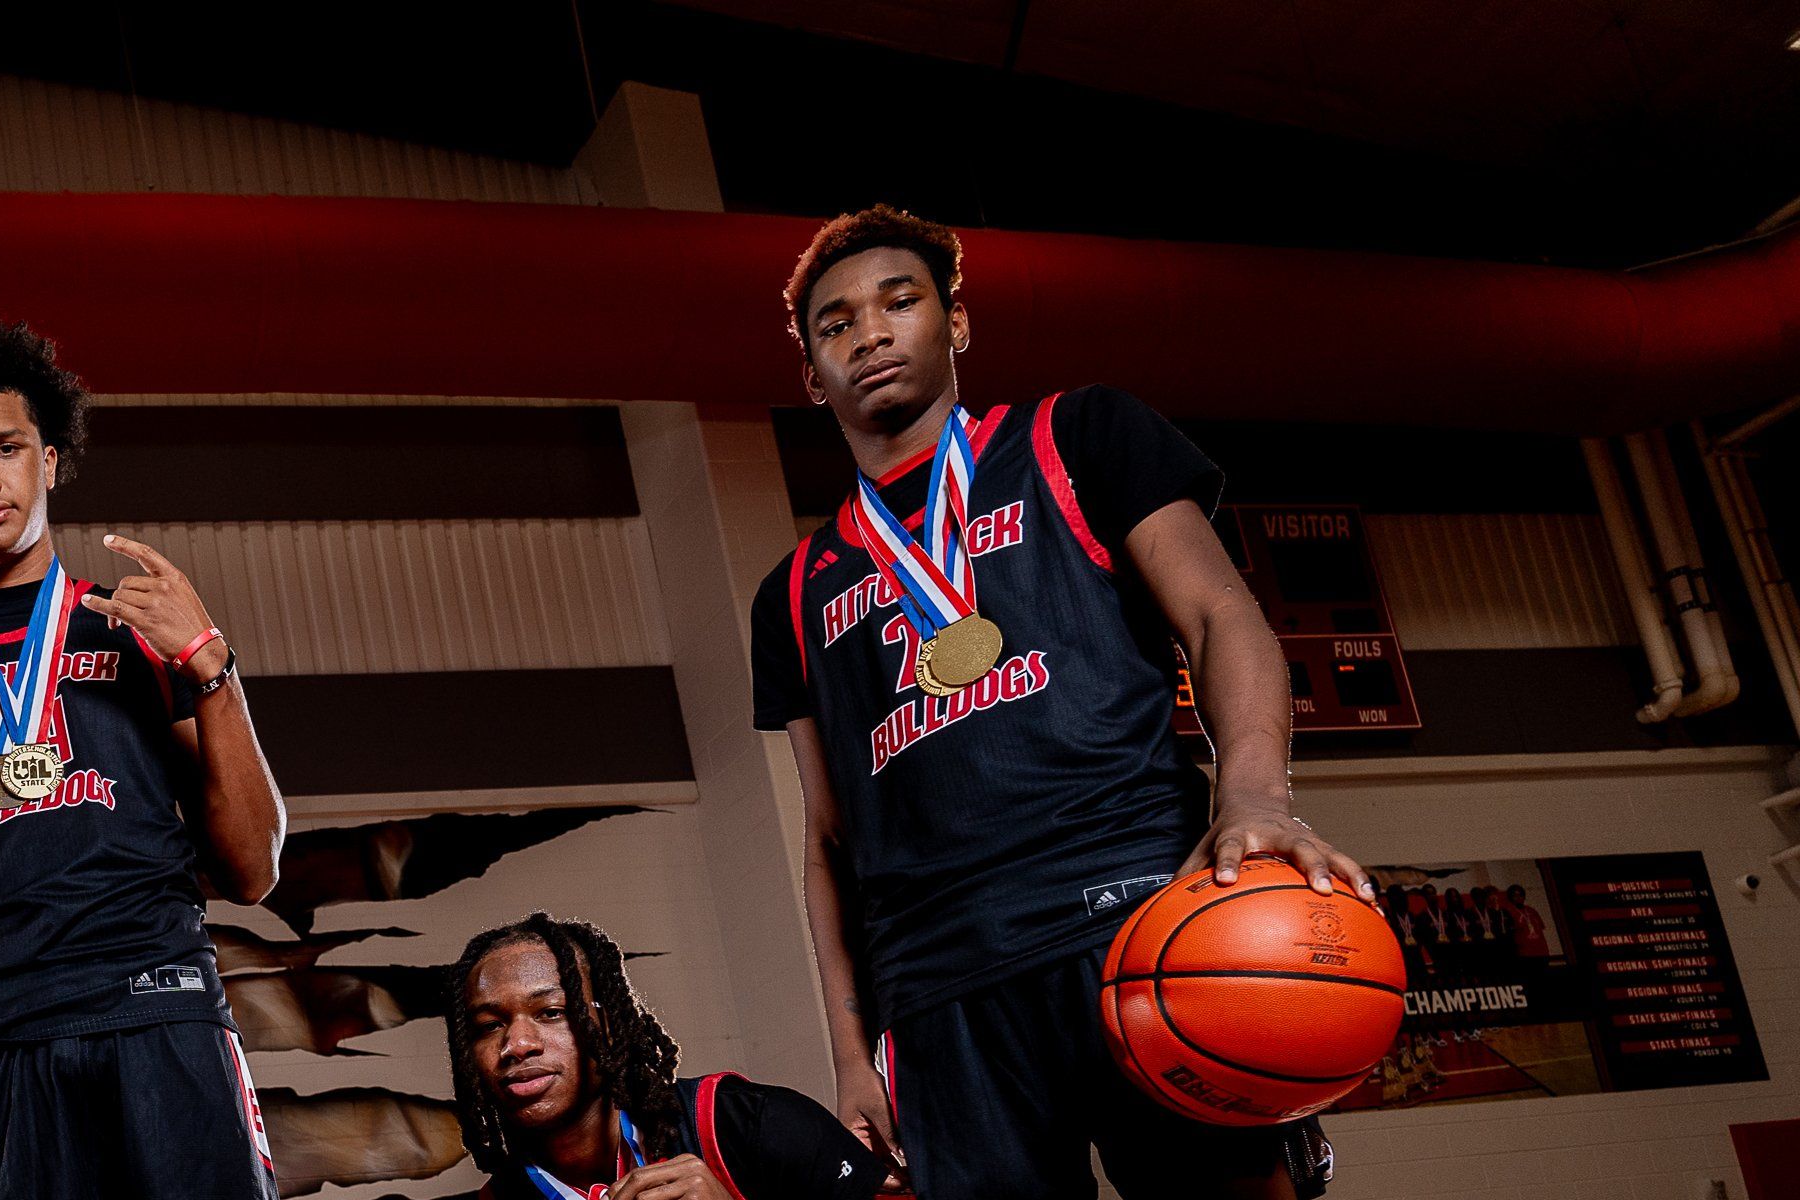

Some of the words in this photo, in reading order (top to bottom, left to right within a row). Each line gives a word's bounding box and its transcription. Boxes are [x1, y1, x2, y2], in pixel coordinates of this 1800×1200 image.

[1263, 514, 1351, 539] VISITOR
[1334, 641, 1382, 657] FOULS
[871, 650, 1050, 776] BULLDOGS
[1358, 710, 1388, 723] WON
[1630, 908, 1654, 917] AREA
[1592, 935, 1634, 946] REGIONAL
[1638, 930, 1707, 943] QUARTERFINALS
[1606, 961, 1648, 972] REGIONAL
[1651, 956, 1708, 969] SEMI-FINALS
[1627, 987, 1669, 998] REGIONAL
[1672, 983, 1703, 994] FINALS
[1403, 985, 1528, 1015] CHAMPIONS
[1629, 1014, 1656, 1025] STATE
[1660, 1010, 1716, 1022] SEMI-FINALS
[1650, 1041, 1677, 1051] STATE
[1681, 1037, 1711, 1047] FINALS
